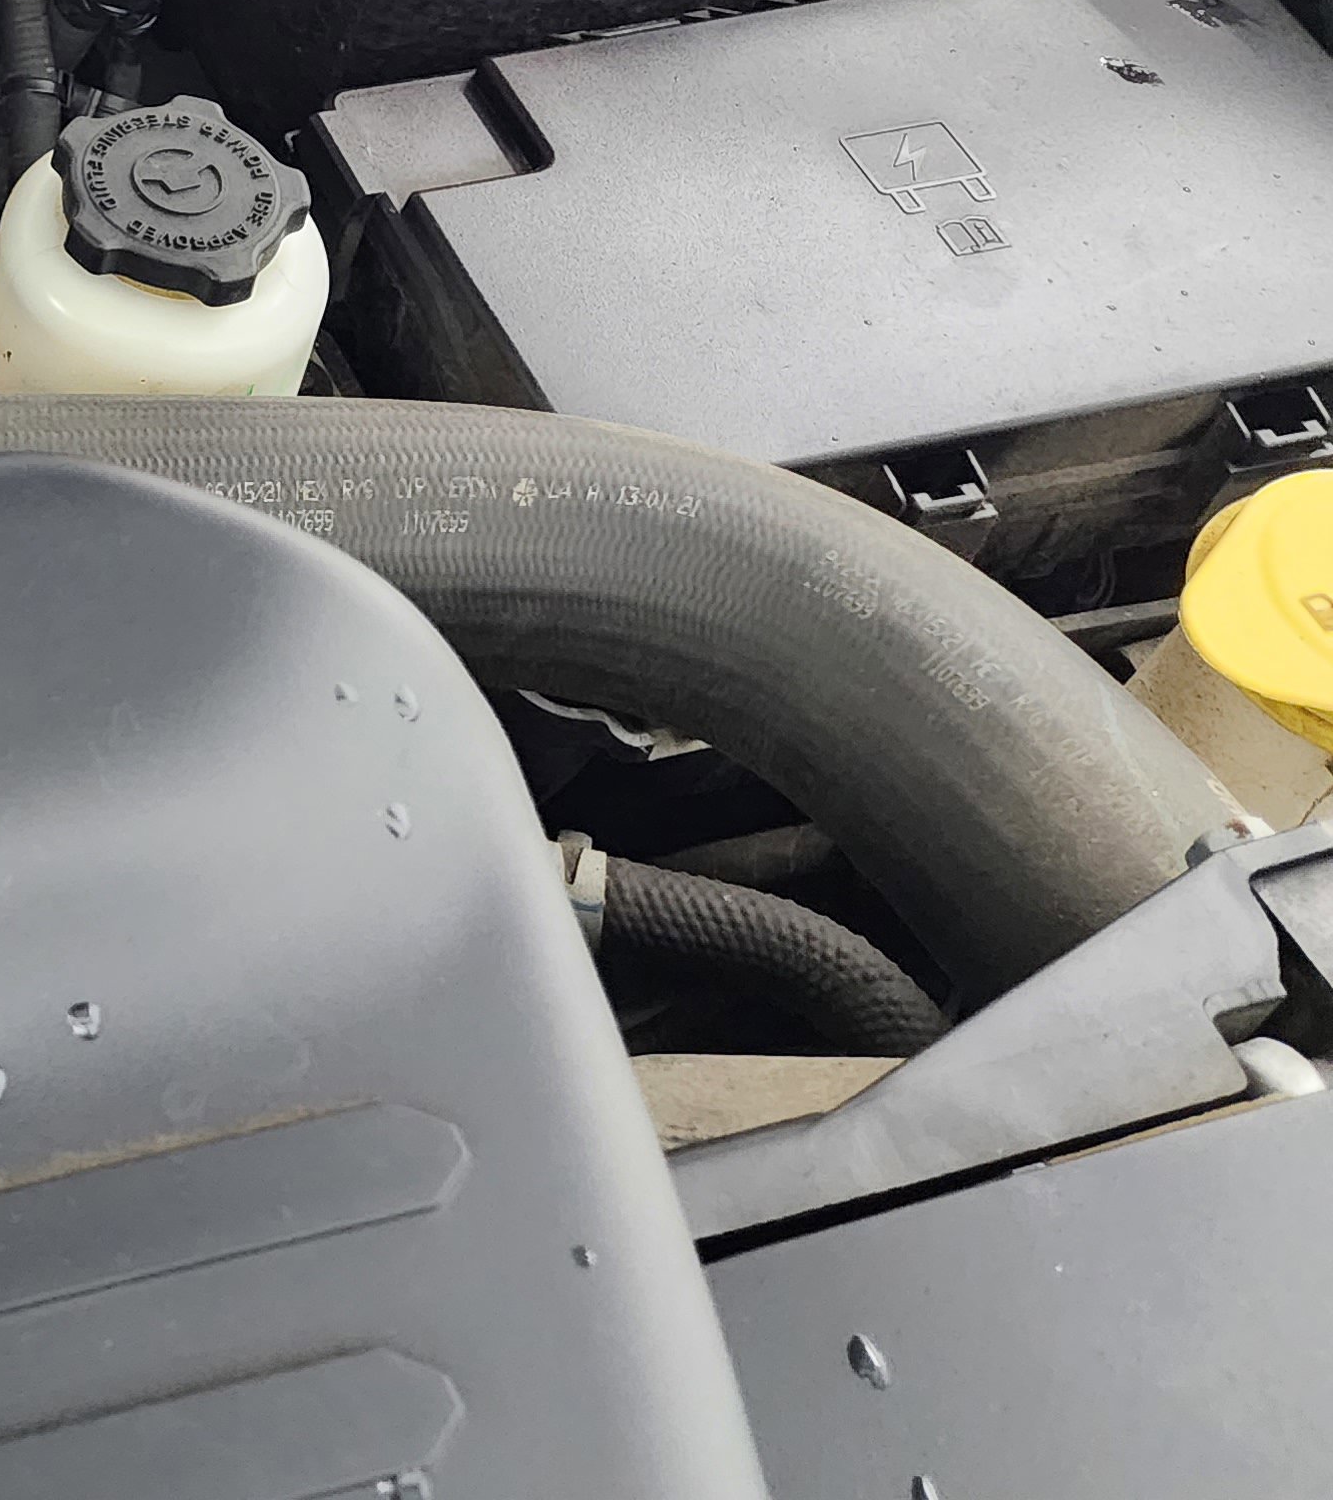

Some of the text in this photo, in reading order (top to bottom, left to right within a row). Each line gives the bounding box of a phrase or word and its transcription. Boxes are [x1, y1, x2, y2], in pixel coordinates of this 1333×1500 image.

[86, 114, 270, 212] POWER STEERING FLUID
[126, 191, 273, 250] USE APPROVED
